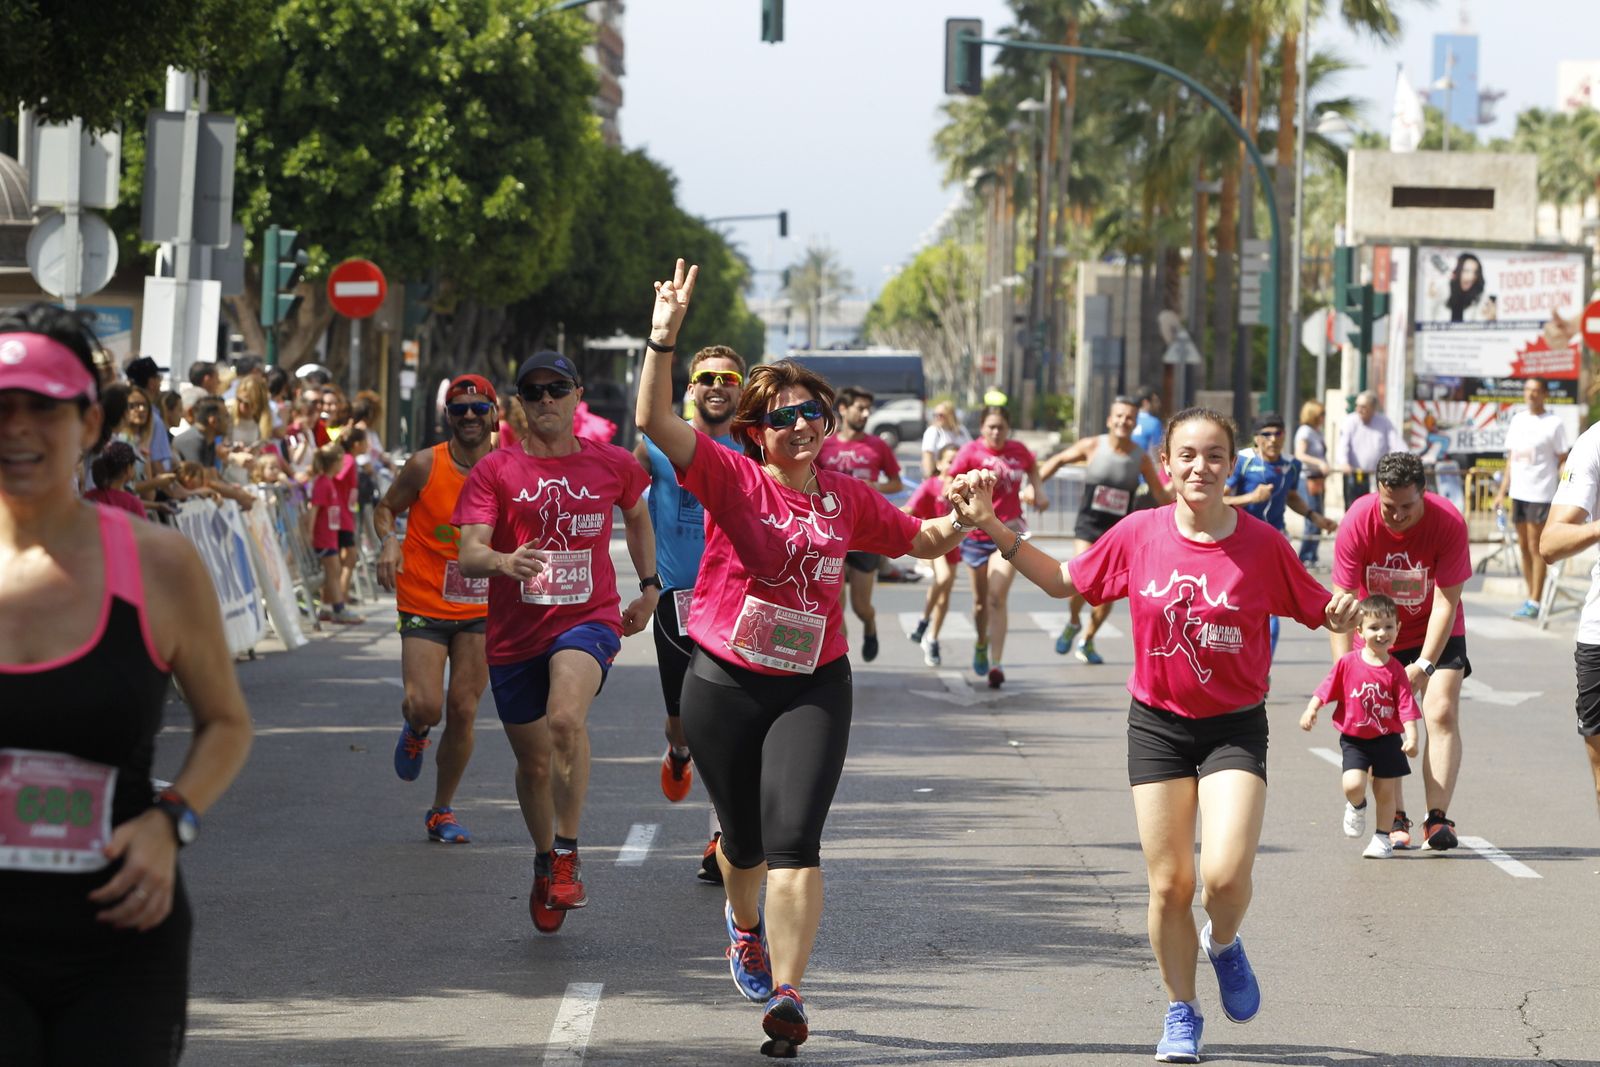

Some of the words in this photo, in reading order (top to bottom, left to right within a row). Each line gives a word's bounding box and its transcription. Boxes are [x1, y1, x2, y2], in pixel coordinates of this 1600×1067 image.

[1498, 270, 1535, 290] TODO
[1540, 265, 1577, 286] TIENE
[567, 514, 578, 536] 4
[545, 566, 588, 584] 1248
[811, 556, 825, 581] 4
[770, 624, 815, 653] 522
[1196, 622, 1209, 648] 4
[17, 786, 92, 827] 688
